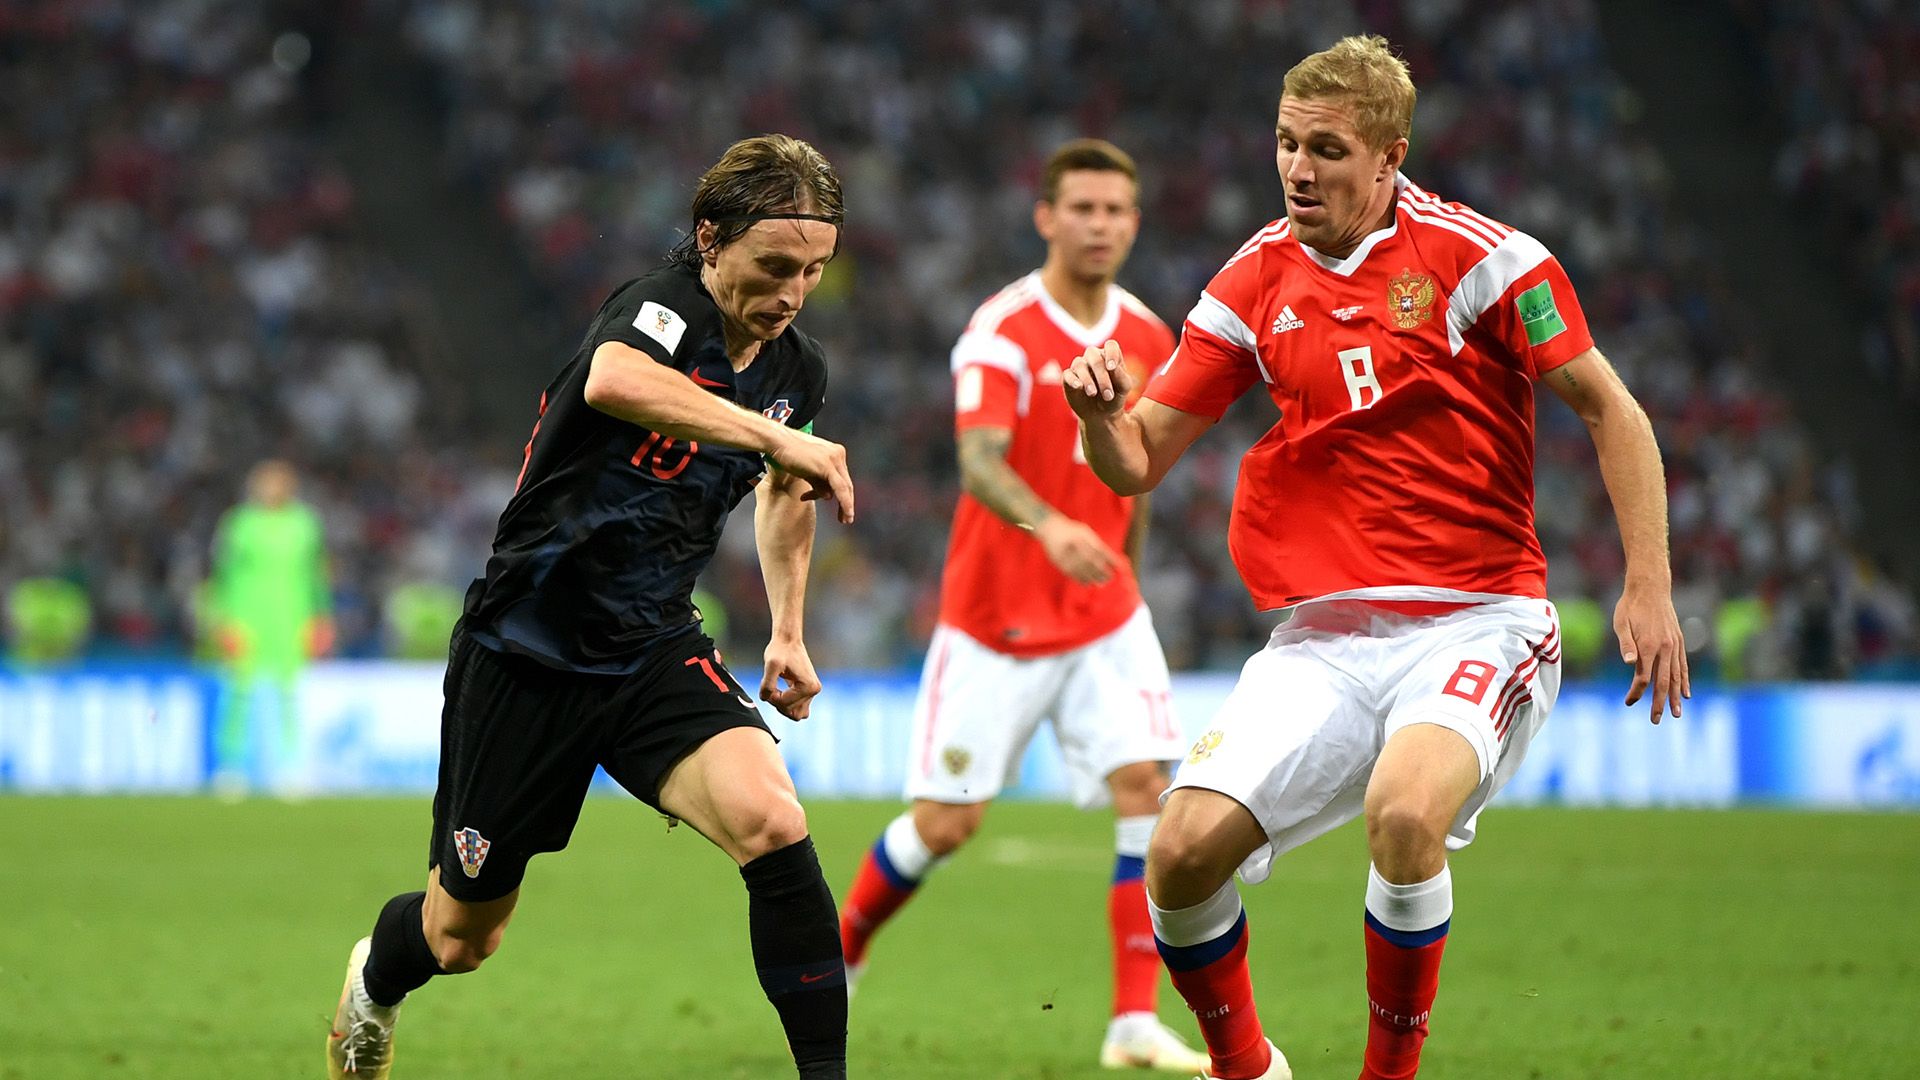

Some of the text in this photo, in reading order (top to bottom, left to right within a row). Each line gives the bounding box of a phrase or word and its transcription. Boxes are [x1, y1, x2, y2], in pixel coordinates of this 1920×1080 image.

[1272, 319, 1305, 335] adidas
[1337, 346, 1383, 411] 8
[631, 431, 698, 480] 10
[1442, 660, 1498, 705] 8
